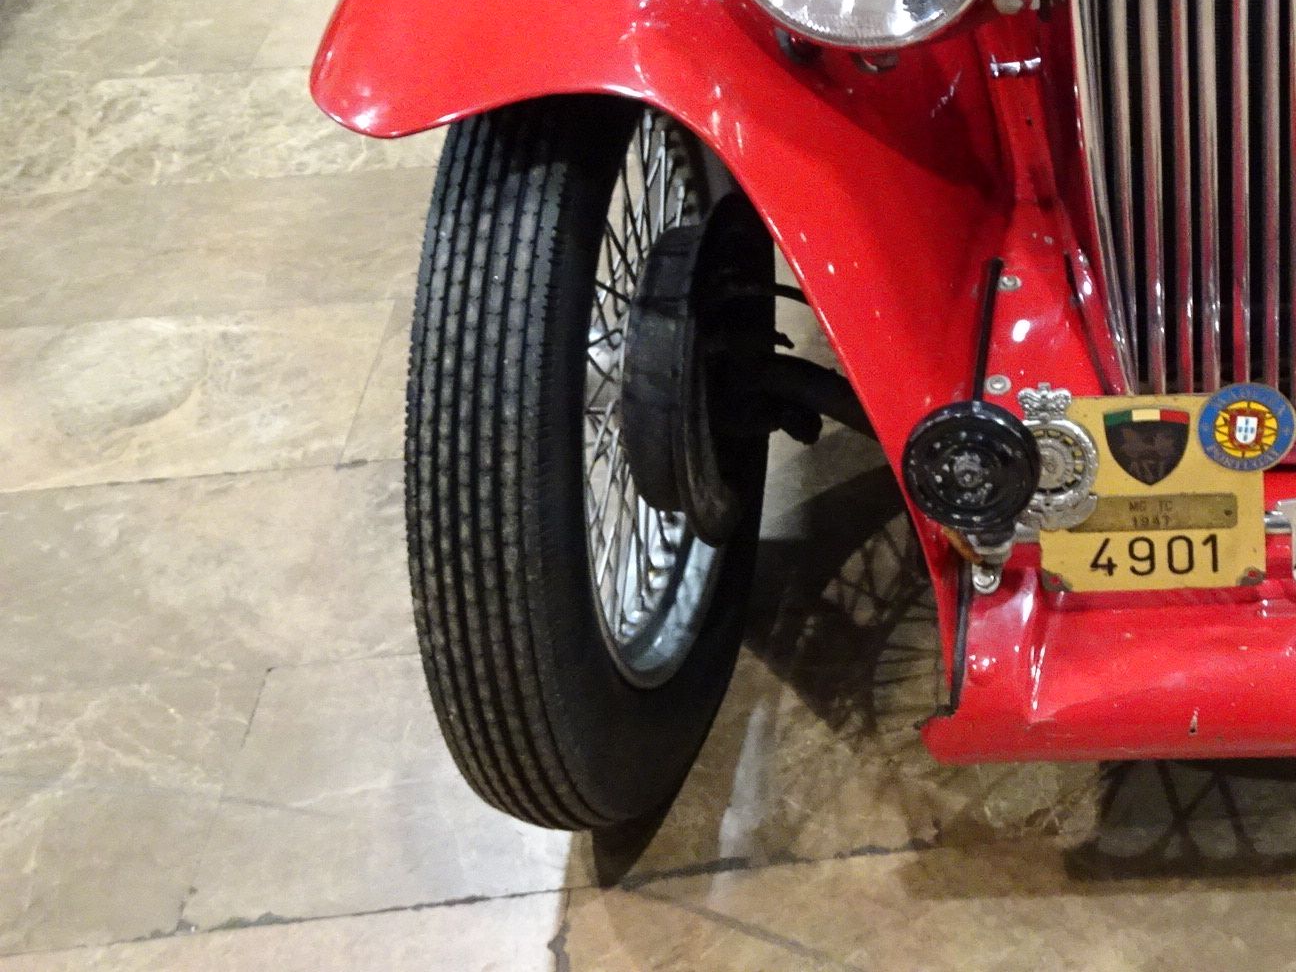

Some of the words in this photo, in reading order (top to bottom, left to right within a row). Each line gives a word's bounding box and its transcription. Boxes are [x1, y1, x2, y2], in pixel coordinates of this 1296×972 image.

[1128, 500, 1147, 512] MG
[1157, 500, 1174, 512] TC
[1131, 515, 1172, 527] 1947
[1090, 533, 1219, 577] 4901
